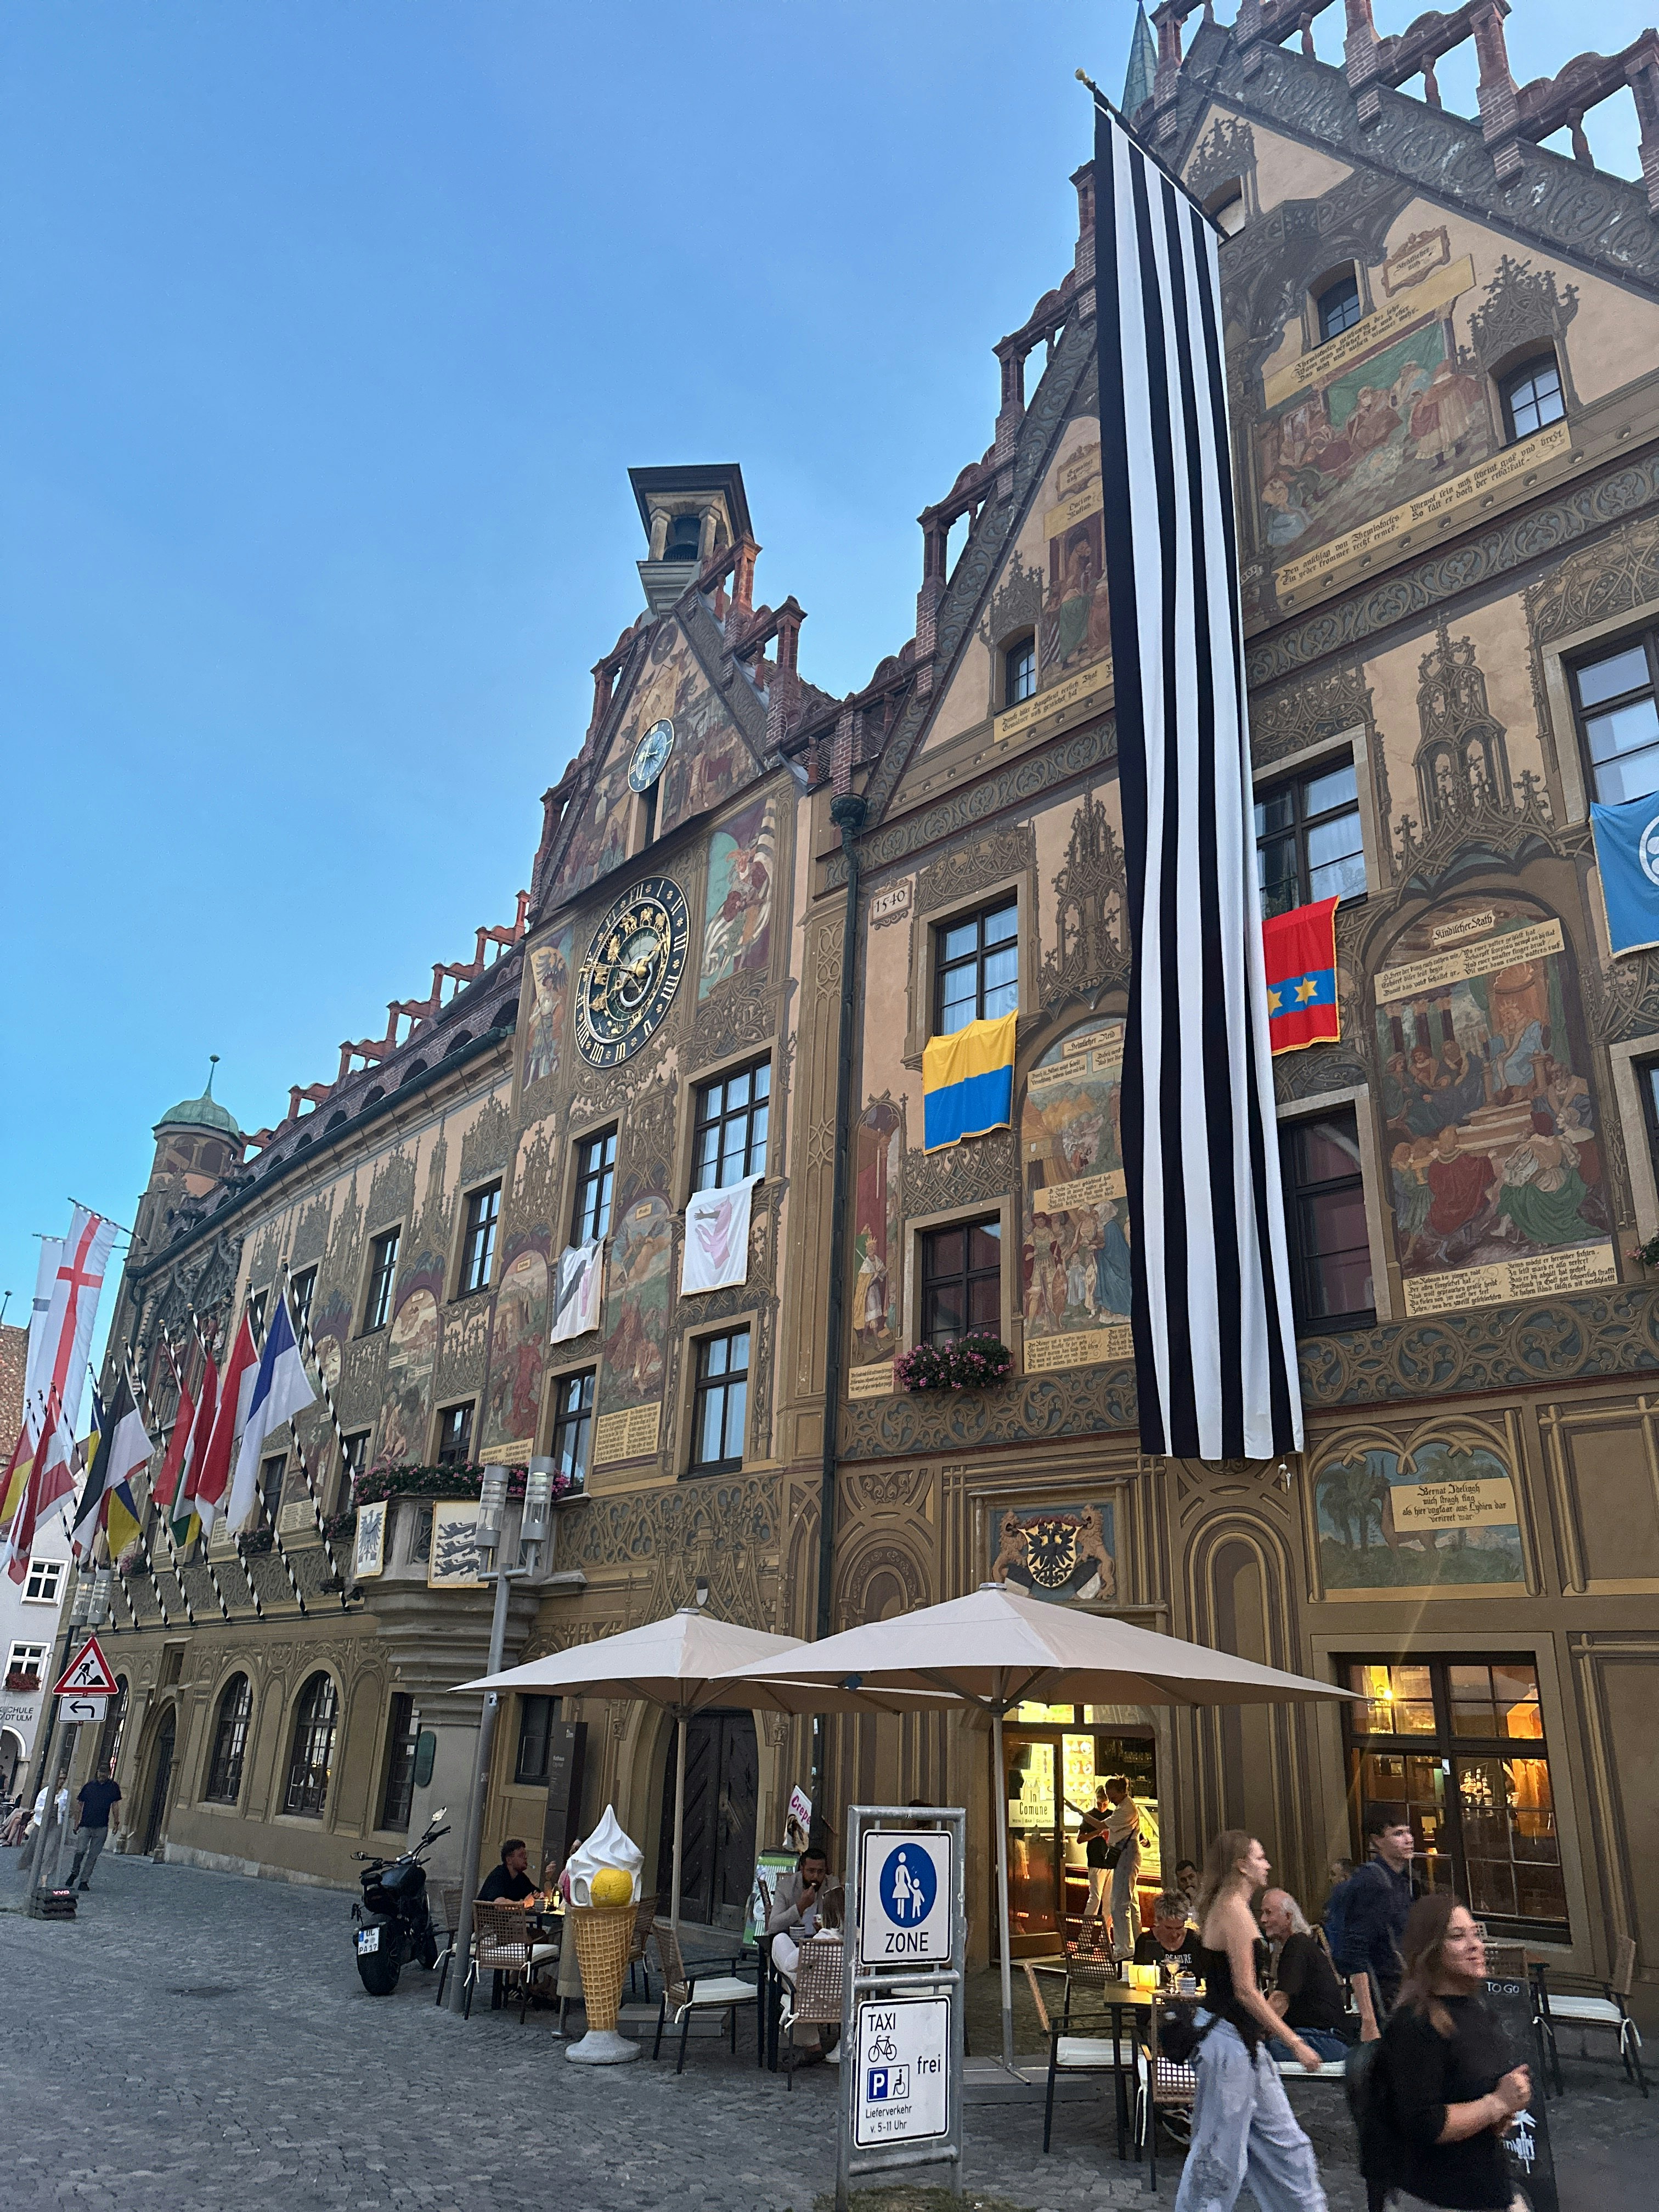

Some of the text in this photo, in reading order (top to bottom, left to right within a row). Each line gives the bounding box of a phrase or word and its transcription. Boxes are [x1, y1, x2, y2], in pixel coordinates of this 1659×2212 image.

[876, 890, 905, 912] 1540
[1030, 1790, 1036, 1803] In
[1020, 1802, 1047, 1815] Comune
[885, 1932, 929, 1953] ZONE
[1486, 1982, 1519, 1993] TO GO
[868, 2013, 895, 2032] TAXI
[918, 2054, 940, 2074] frei
[866, 2103, 912, 2119] Lieferverkehr
[870, 2120, 907, 2133] v. 5-11 Uhr
